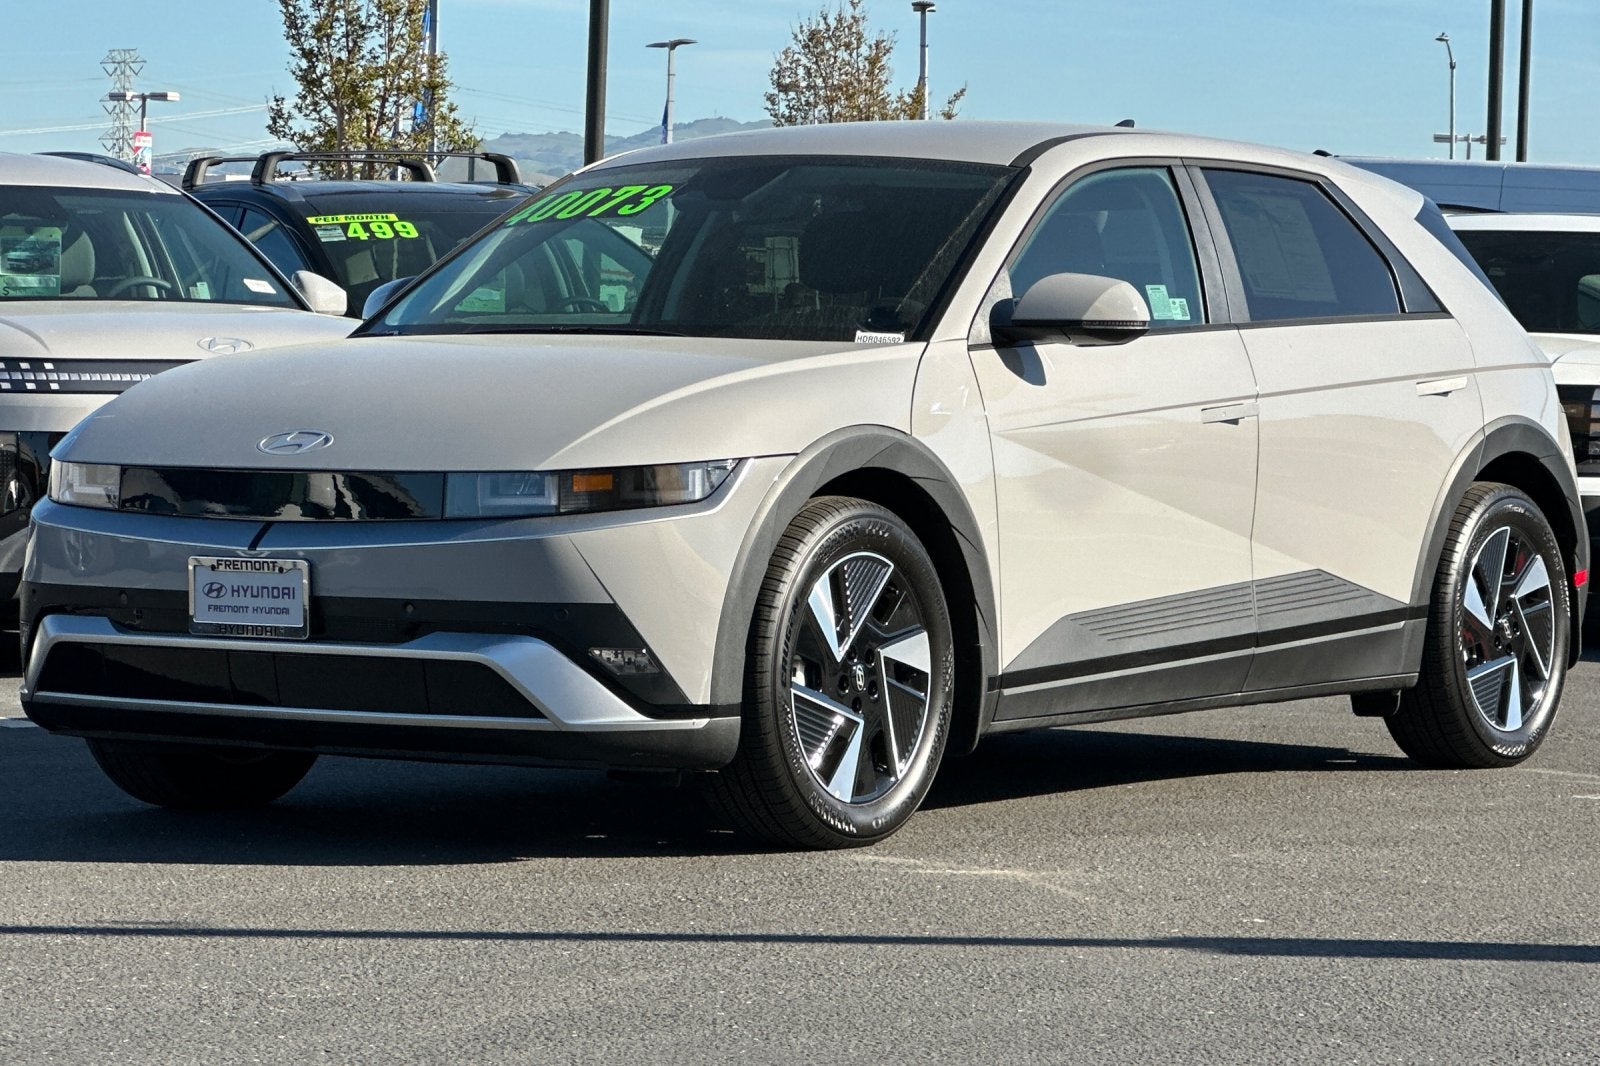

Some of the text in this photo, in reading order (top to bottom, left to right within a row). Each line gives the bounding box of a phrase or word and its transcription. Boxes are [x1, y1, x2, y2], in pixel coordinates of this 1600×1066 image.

[505, 185, 673, 226] 40073
[347, 221, 419, 240] 499
[215, 559, 278, 572] FREMONT
[231, 584, 295, 600] HYUNDAI
[207, 604, 290, 615] FREMONT HYUNDAI
[219, 624, 277, 636] HYUNDAI
